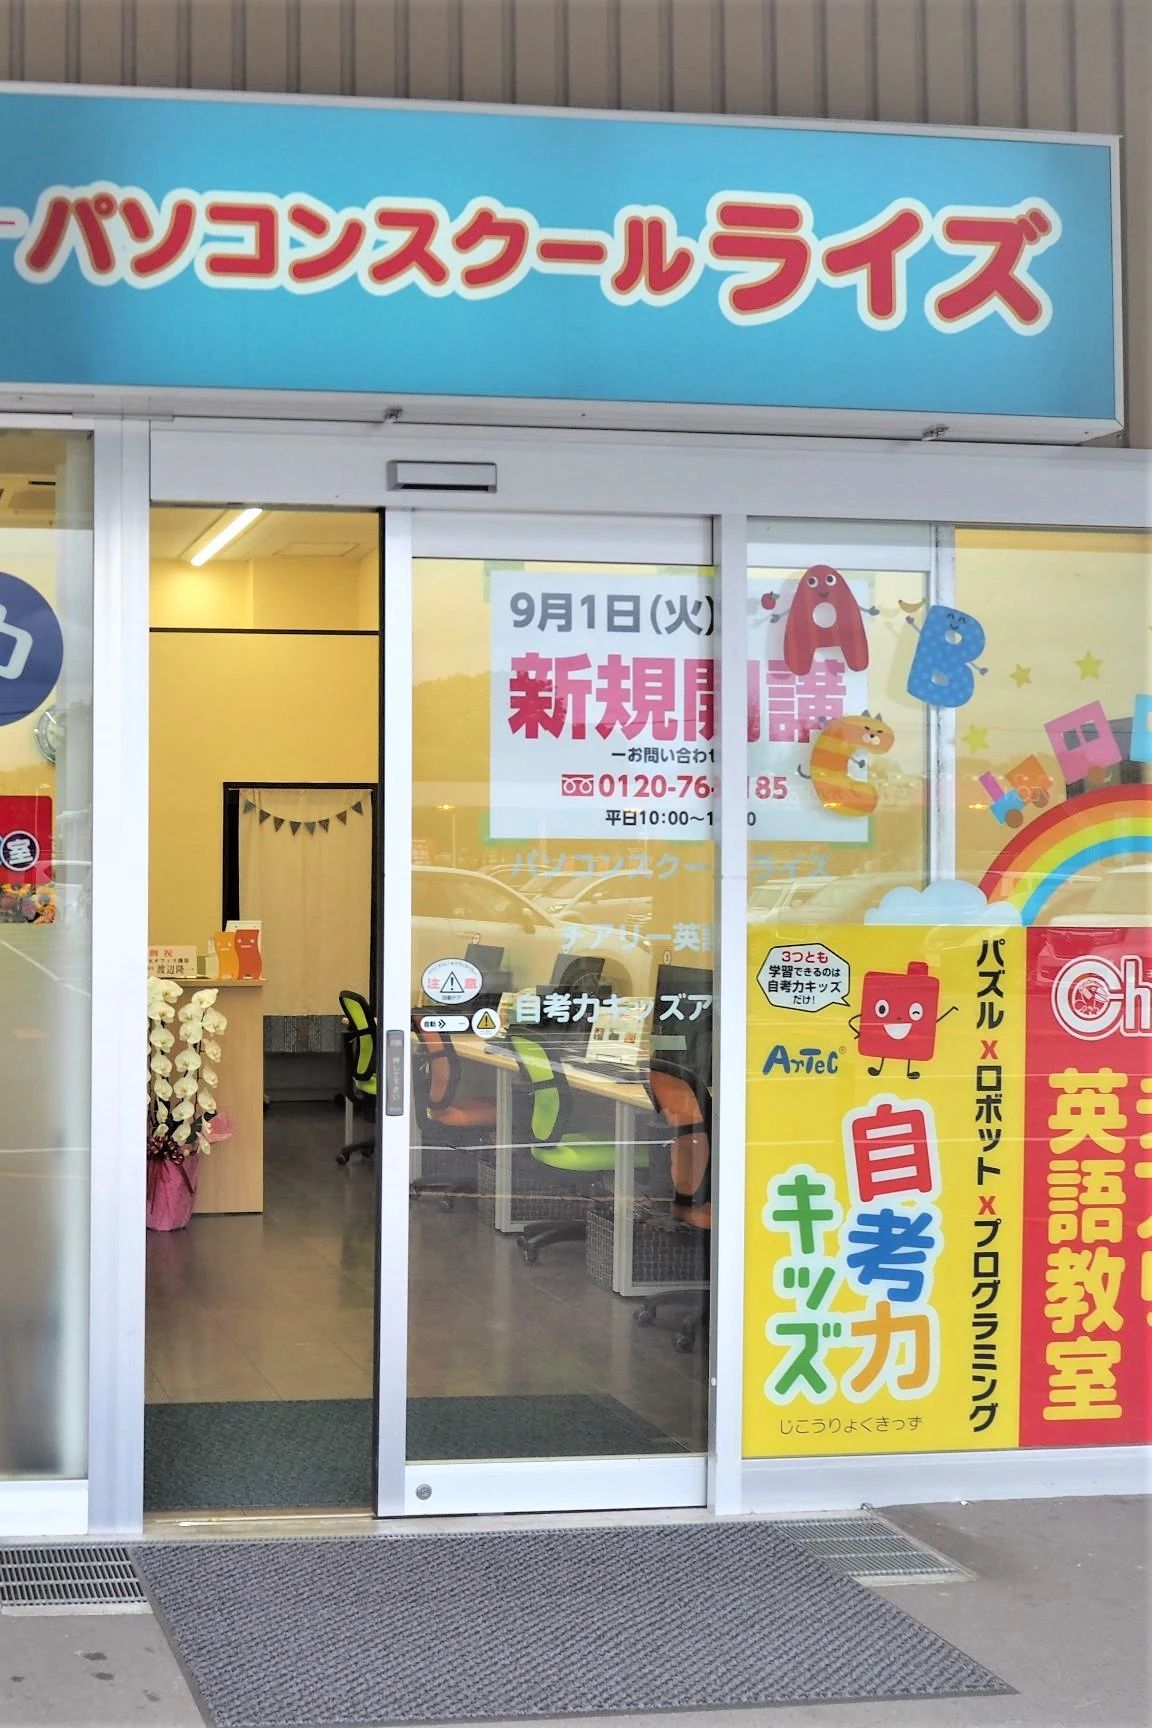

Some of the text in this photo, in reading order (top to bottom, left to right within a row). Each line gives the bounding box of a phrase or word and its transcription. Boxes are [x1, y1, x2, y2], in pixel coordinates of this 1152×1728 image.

[23, 191, 1052, 325] パソコンスクールライズ
[768, 980, 842, 993] 自考力キッズ
[769, 965, 841, 979] 学習できるのは
[781, 950, 829, 964] 3つとも
[846, 1102, 937, 1396] 自考力
[1043, 1066, 1129, 1422] 英語教室
[772, 1173, 843, 1396] キッズ
[779, 1415, 923, 1435] じこうりょくきっず
